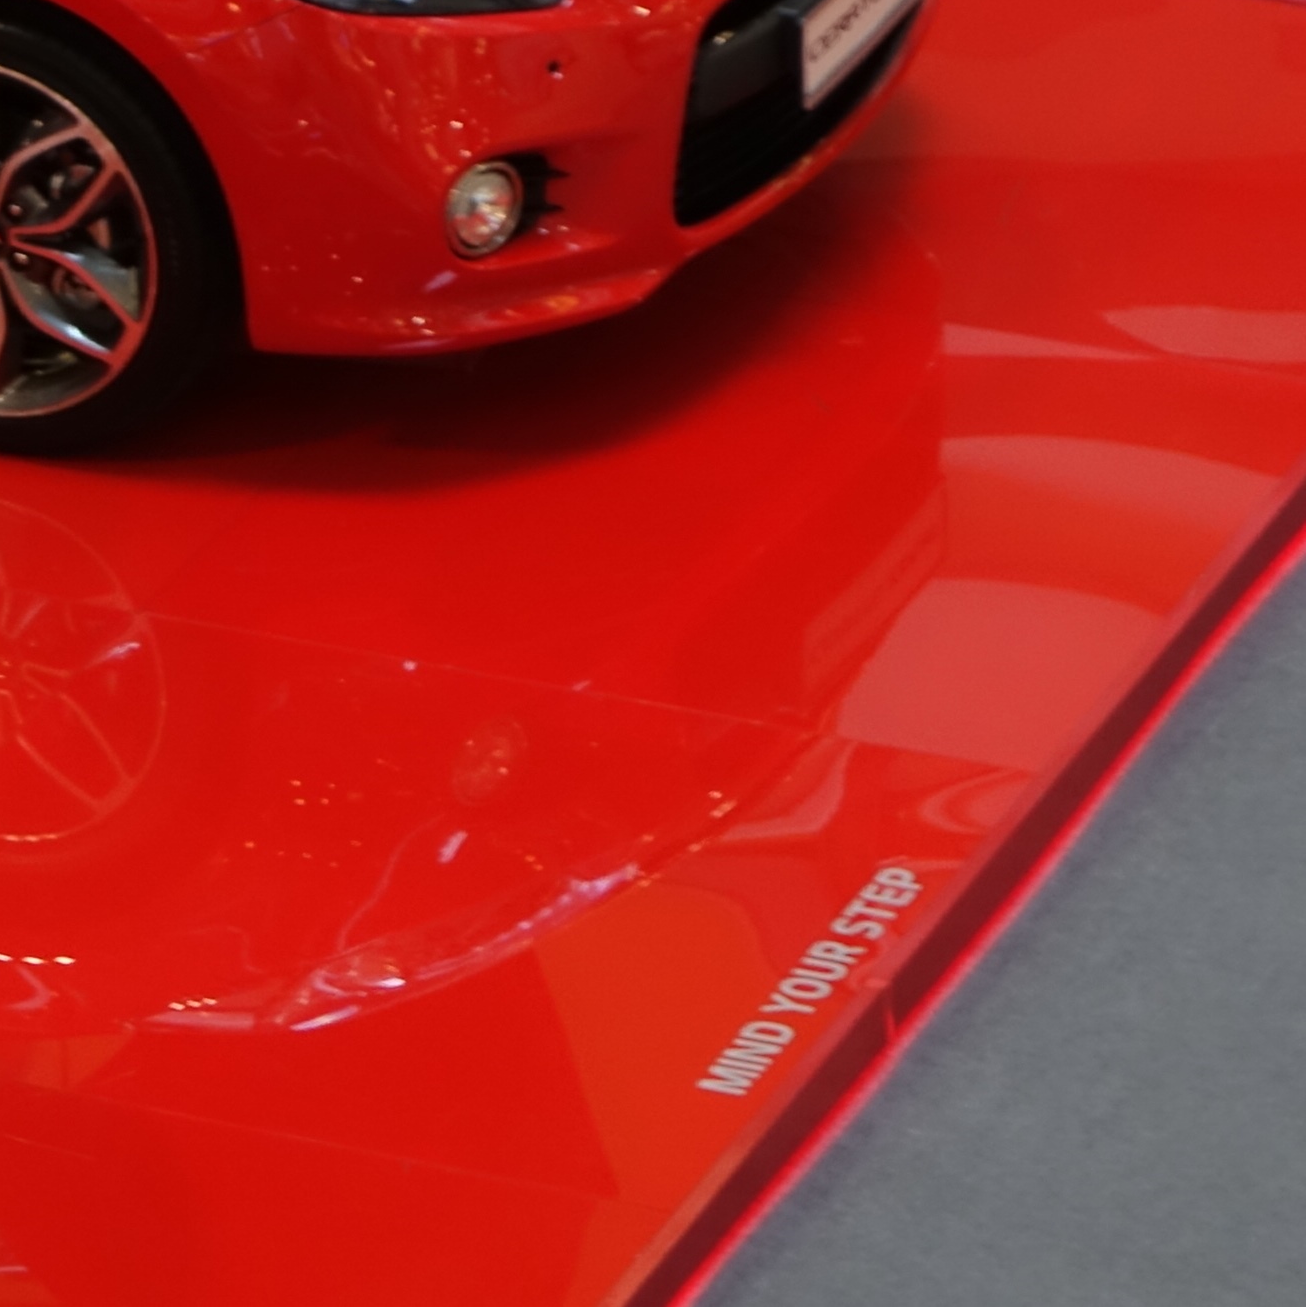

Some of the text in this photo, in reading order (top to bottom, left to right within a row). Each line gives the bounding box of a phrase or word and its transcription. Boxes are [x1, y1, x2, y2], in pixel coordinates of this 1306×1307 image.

[695, 867, 923, 1096] MIND YOUR STEP
